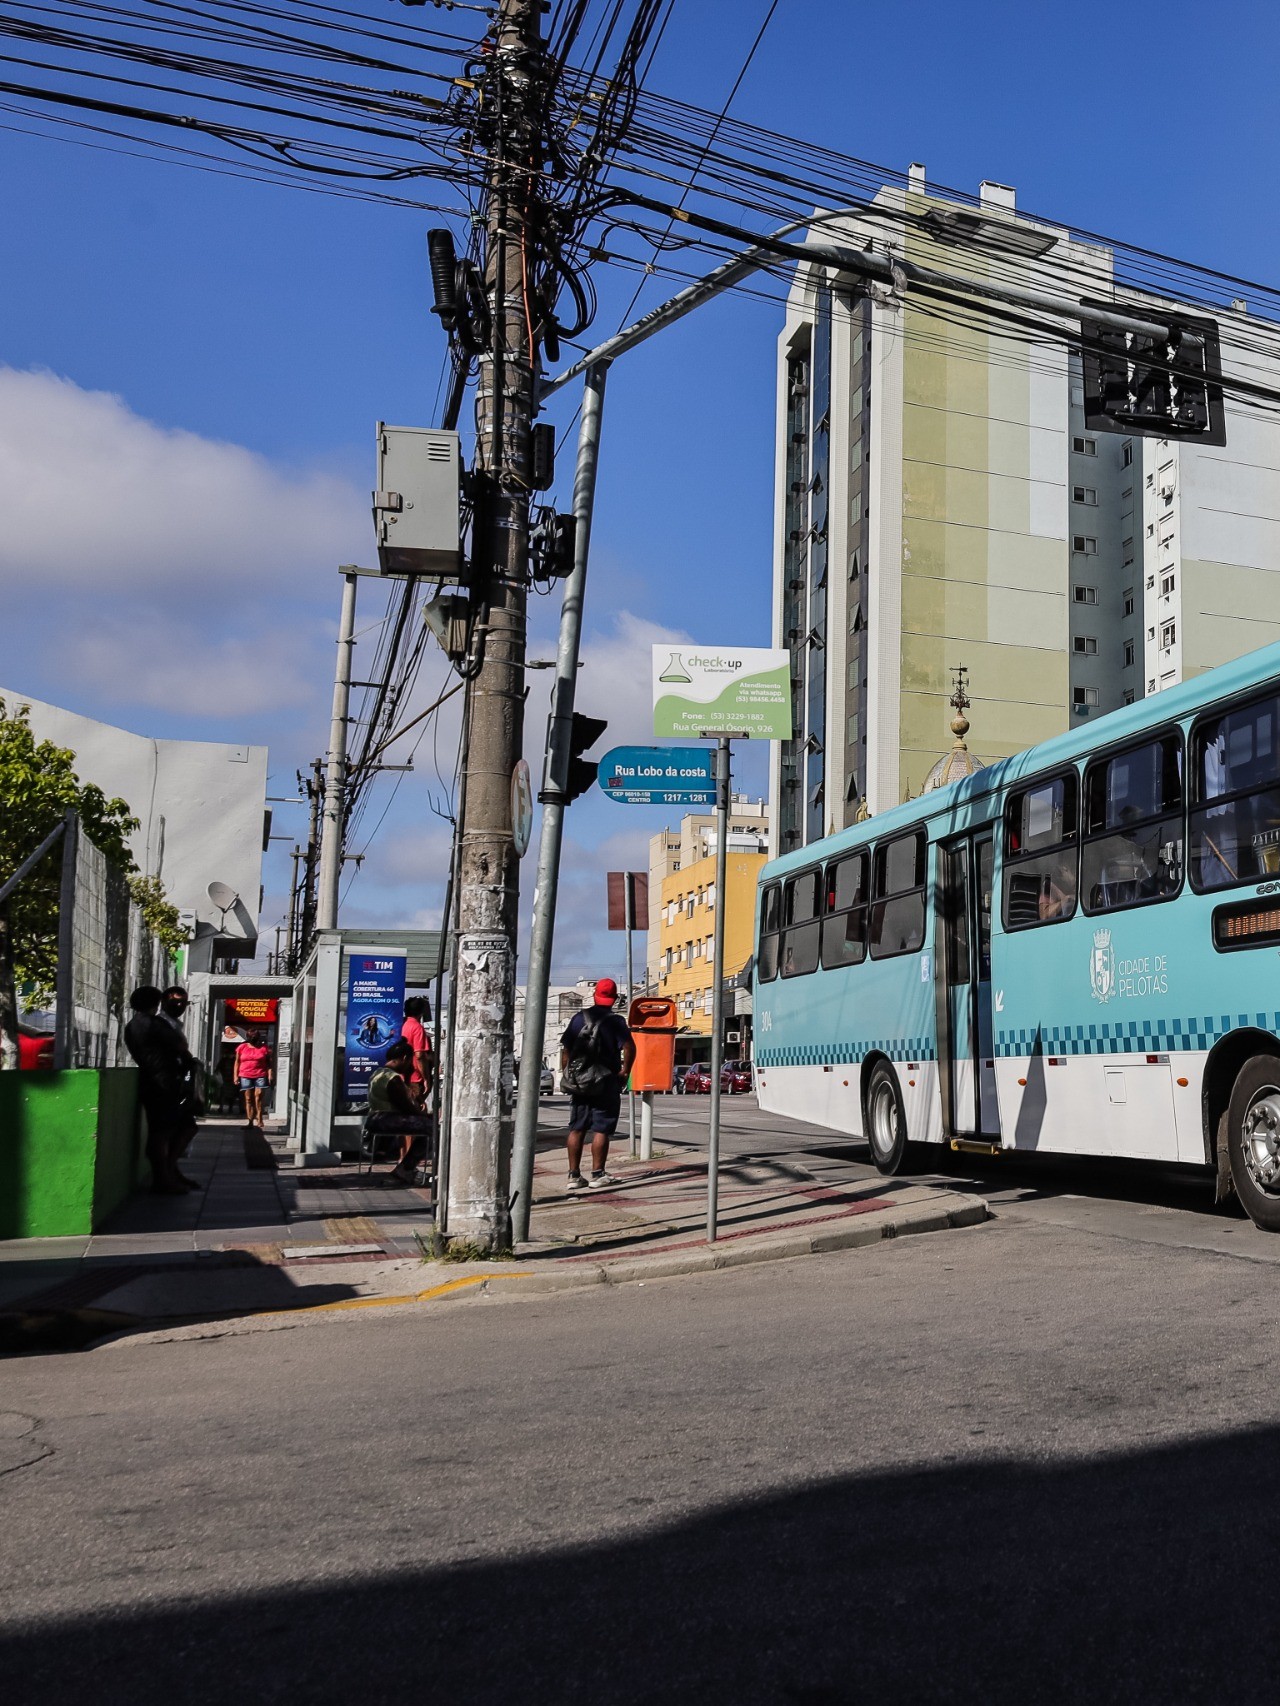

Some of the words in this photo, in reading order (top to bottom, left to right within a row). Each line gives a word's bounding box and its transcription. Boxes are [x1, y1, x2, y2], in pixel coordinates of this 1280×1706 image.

[682, 712, 706, 720] Fone:
[711, 712, 725, 721] (53)
[673, 723, 689, 731] Rua
[691, 723, 725, 732] General
[757, 725, 773, 733] 926
[615, 765, 635, 776] Rua
[638, 766, 663, 776] Lobo
[665, 766, 678, 777] da
[680, 767, 707, 777] costa
[663, 794, 682, 802] 1217
[689, 794, 707, 802] 1281
[374, 961, 394, 970] TIM
[1119, 957, 1150, 975] CIDADE
[1154, 955, 1168, 971] DE
[1119, 974, 1168, 997] PELOTAS
[761, 1010, 772, 1032] 304
